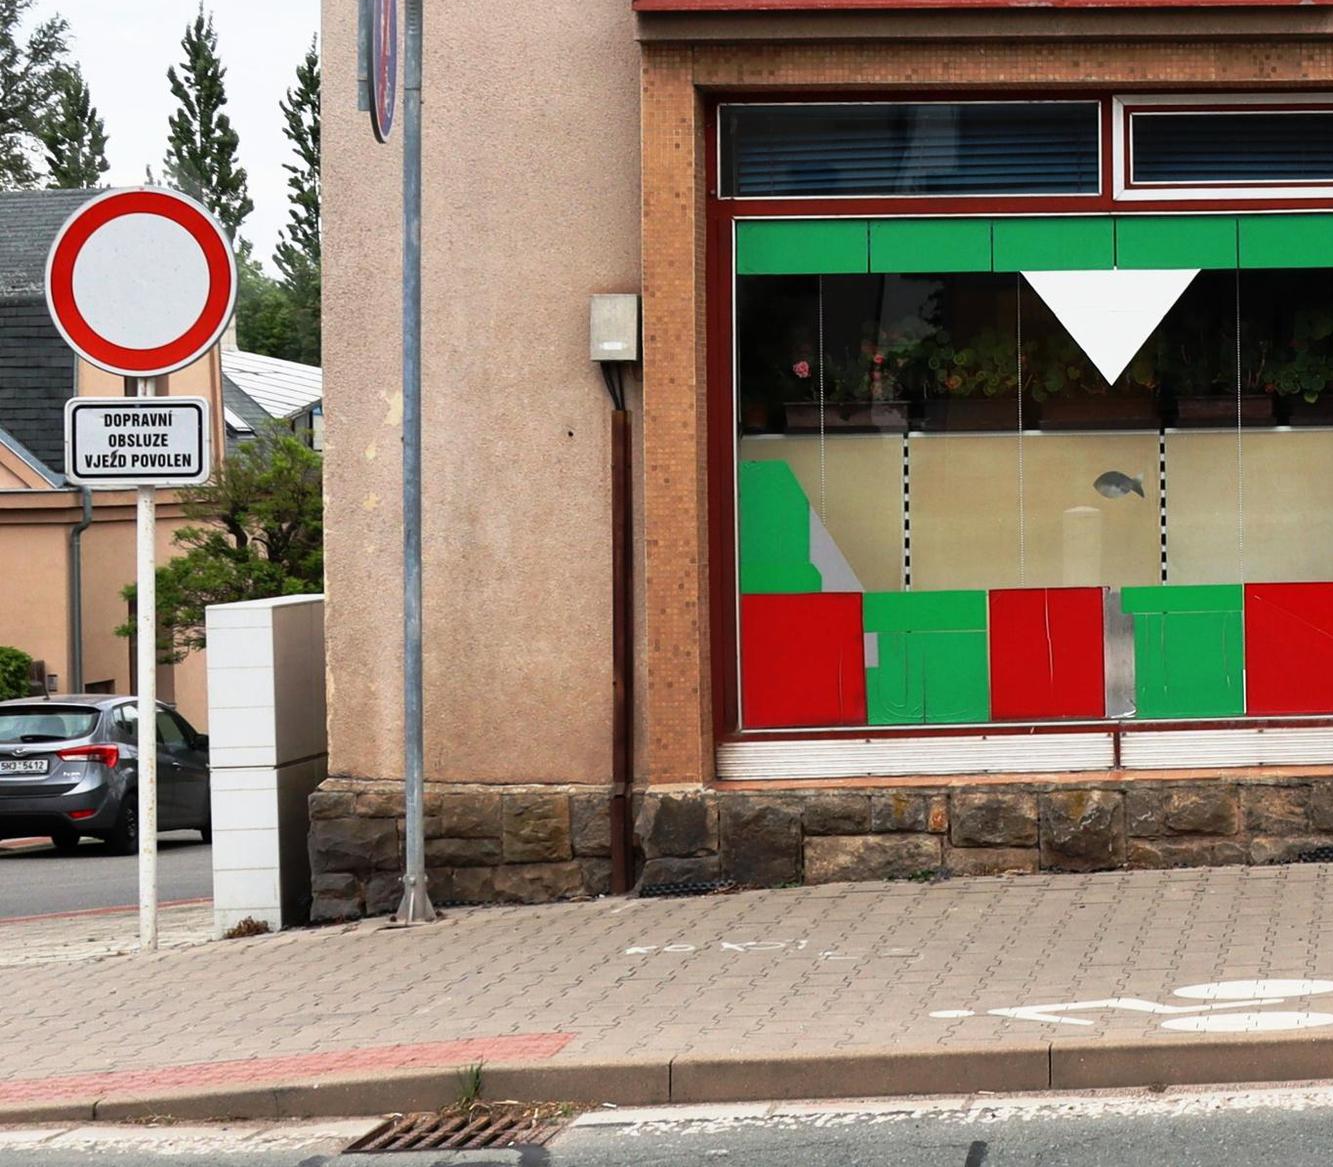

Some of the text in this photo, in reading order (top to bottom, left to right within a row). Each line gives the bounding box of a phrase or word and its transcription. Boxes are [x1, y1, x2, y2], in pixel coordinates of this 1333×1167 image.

[104, 410, 172, 427] DOPRAVNÍ
[109, 434, 169, 447] OBSLUZE
[131, 453, 192, 468] POVOLEN
